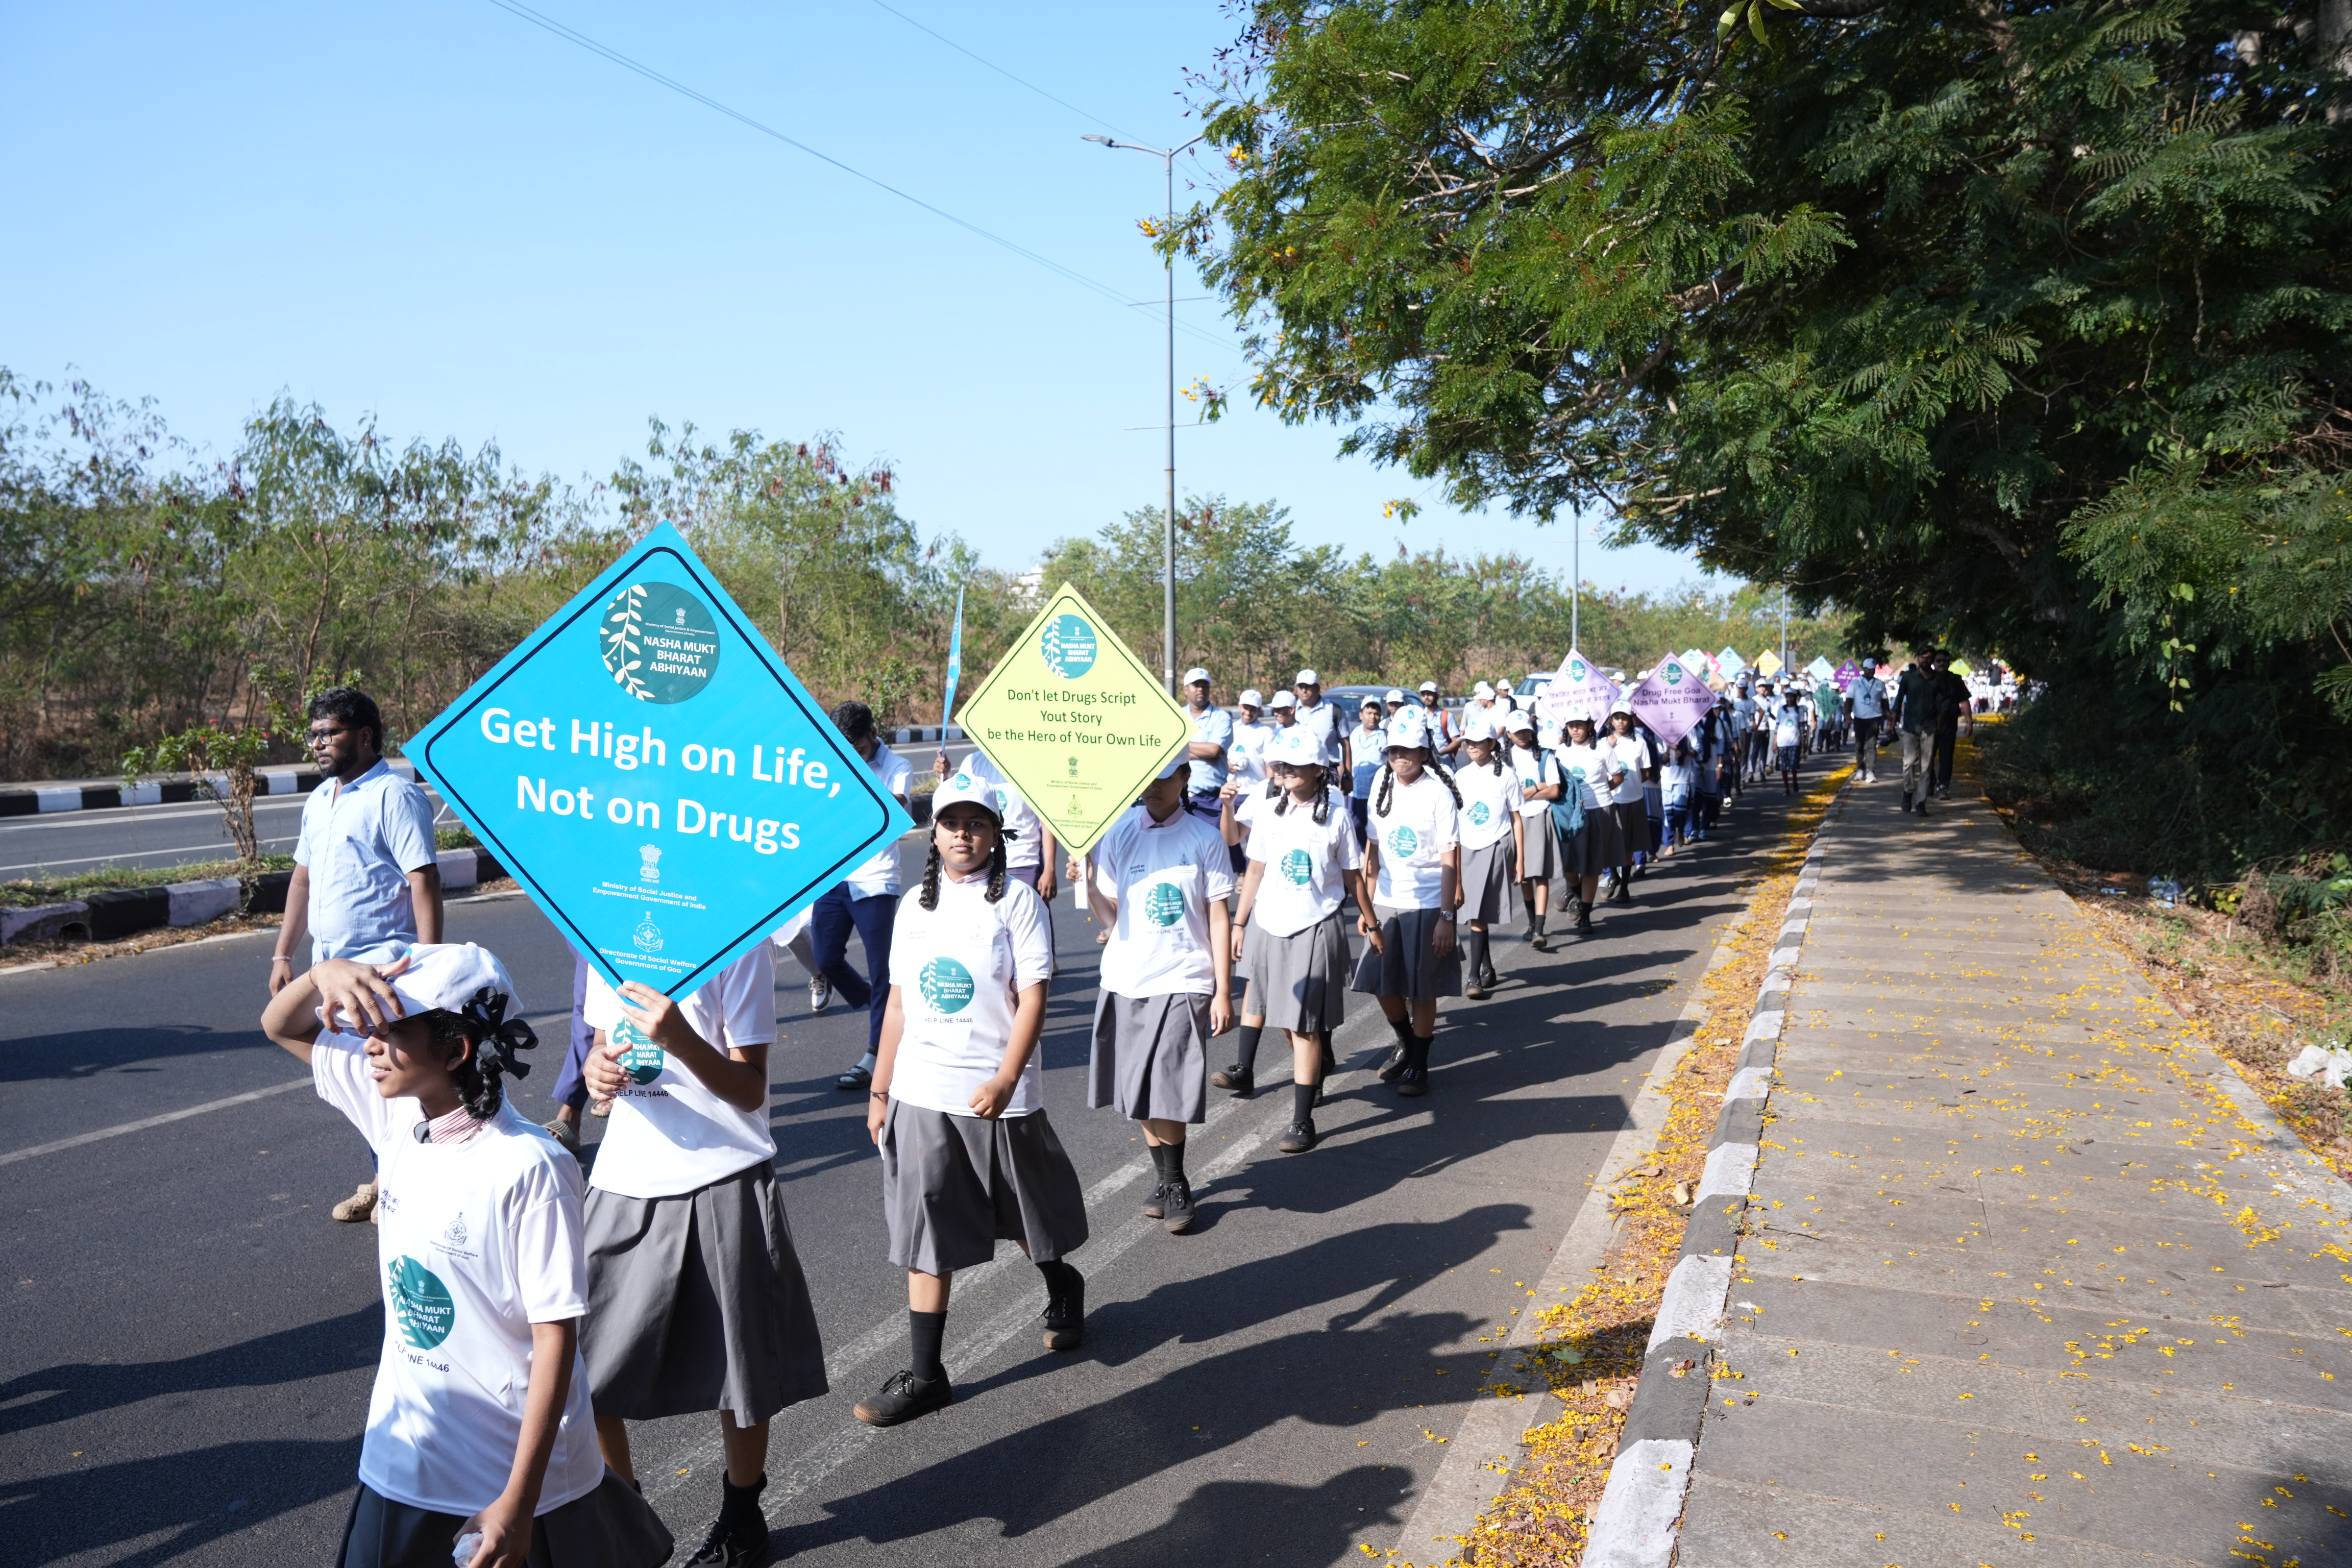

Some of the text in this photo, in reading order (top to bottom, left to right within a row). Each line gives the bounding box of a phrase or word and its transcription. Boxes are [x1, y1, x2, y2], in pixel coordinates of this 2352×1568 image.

[644, 635, 716, 654] NASHA MUKT
[657, 650, 701, 665] BHARAT
[649, 662, 707, 678] ABHIYAAN
[1008, 689, 1136, 706] Don't let Drugs Script
[1040, 710, 1102, 726] Yout Story
[988, 728, 1161, 747] be the Hero of Your Own Life
[481, 707, 841, 798] Get High on Life,
[517, 775, 800, 854] Not on Drugs
[593, 887, 639, 899] Empowerment
[640, 895, 680, 905] Government
[602, 881, 628, 892] Ministry
[638, 887, 657, 895] Social
[659, 890, 683, 899] Justice
[599, 948, 638, 959] Directorate
[648, 955, 669, 964] Social
[670, 959, 697, 968] Welfare
[615, 958, 658, 970] Government
[435, 1247, 457, 1256] Government
[400, 1295, 452, 1315] NASHA MUKT
[407, 1308, 440, 1324] BHARAT
[426, 1359, 450, 1372] 14446
